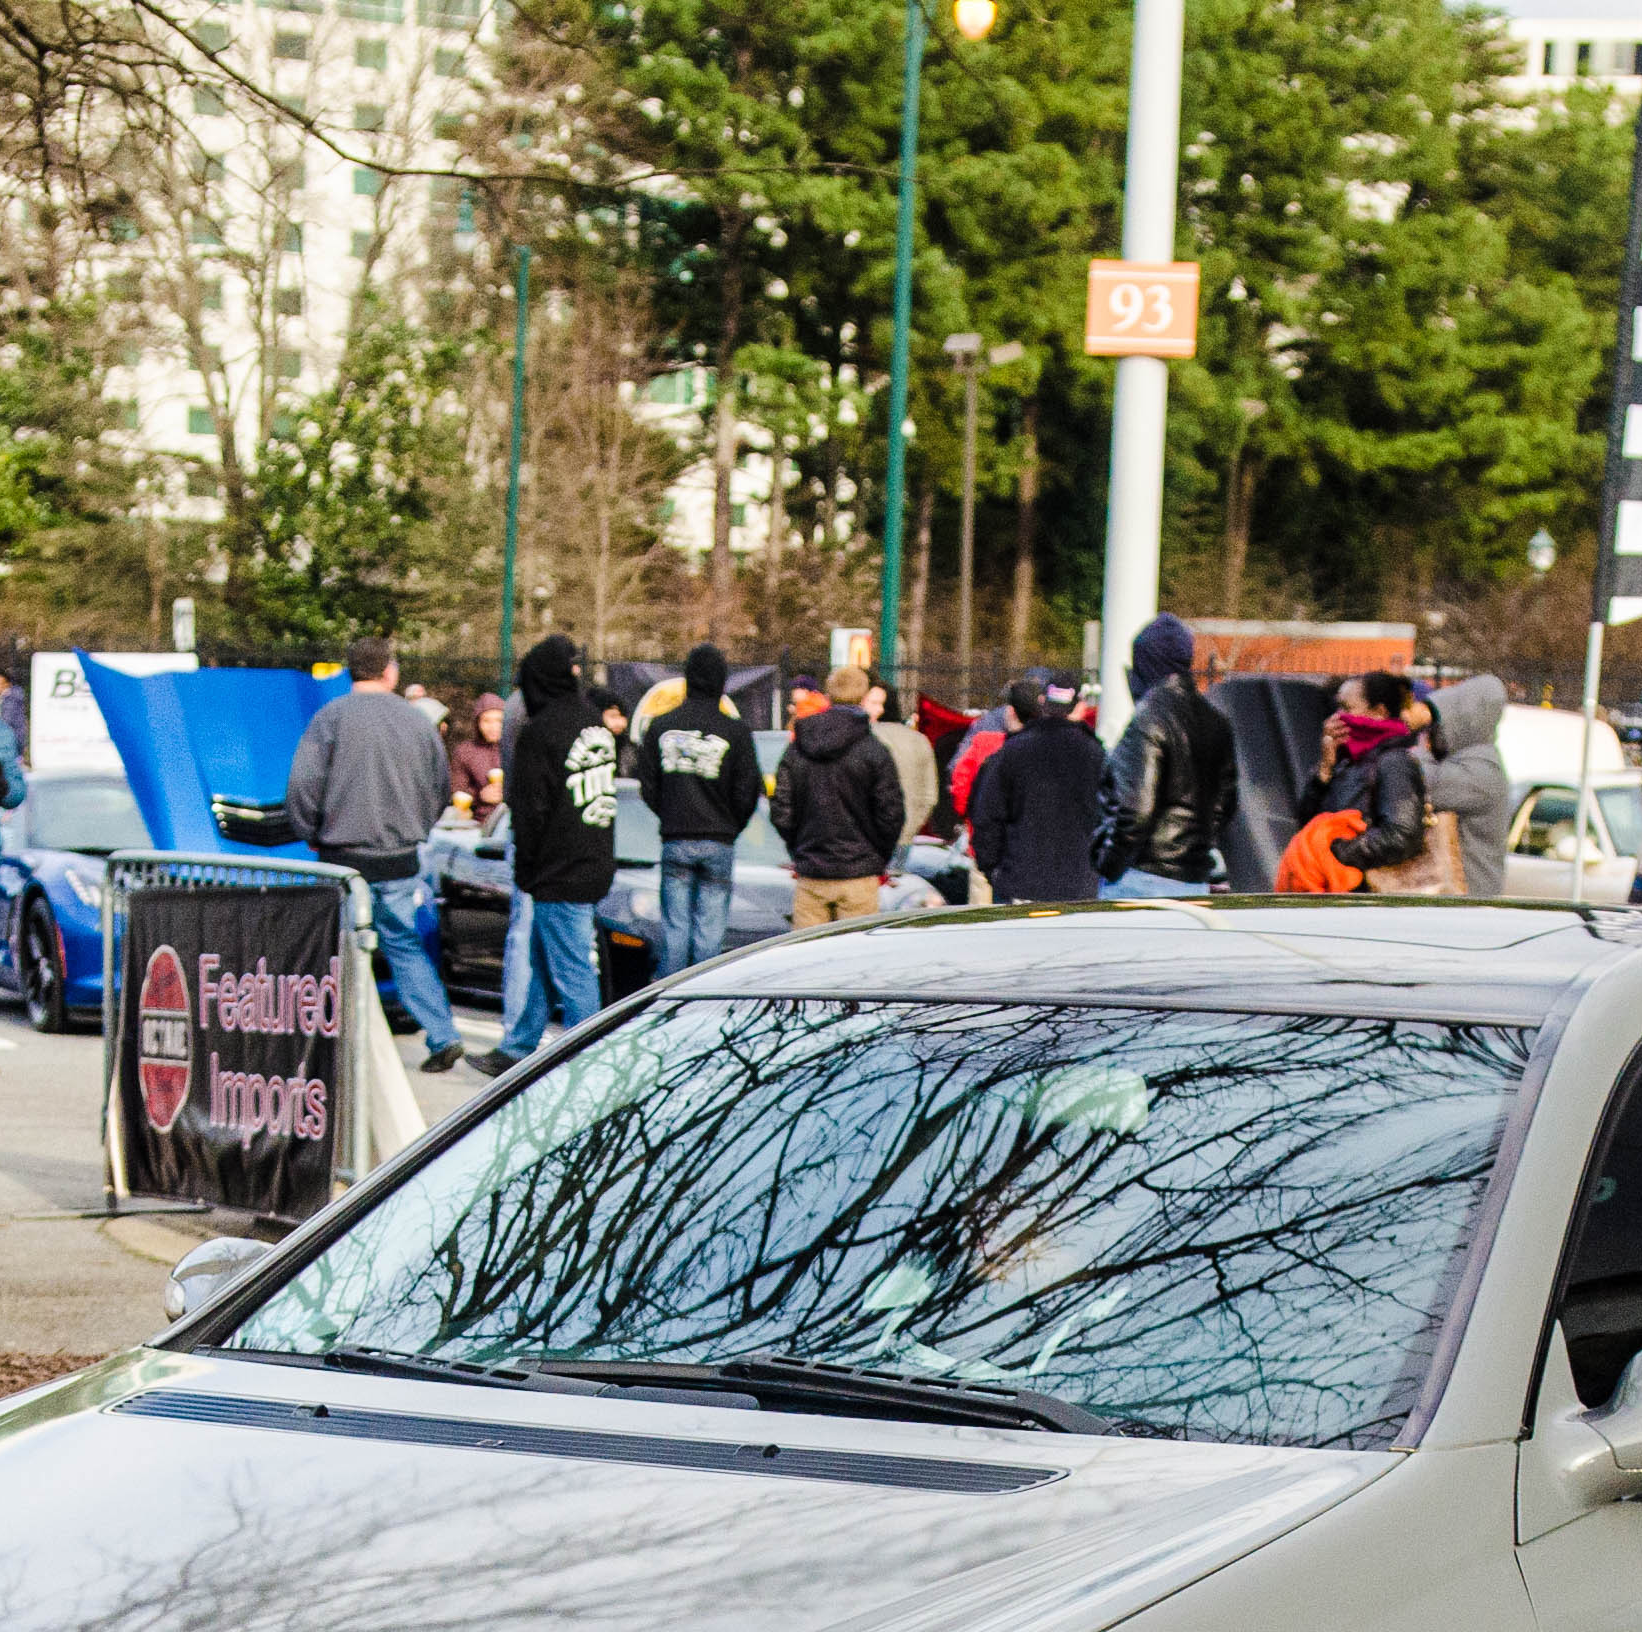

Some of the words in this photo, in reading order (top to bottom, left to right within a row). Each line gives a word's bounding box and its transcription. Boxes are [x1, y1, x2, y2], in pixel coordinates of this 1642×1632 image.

[1110, 283, 1173, 333] 93
[198, 952, 341, 1039] Featured
[209, 1051, 327, 1150] Imports
